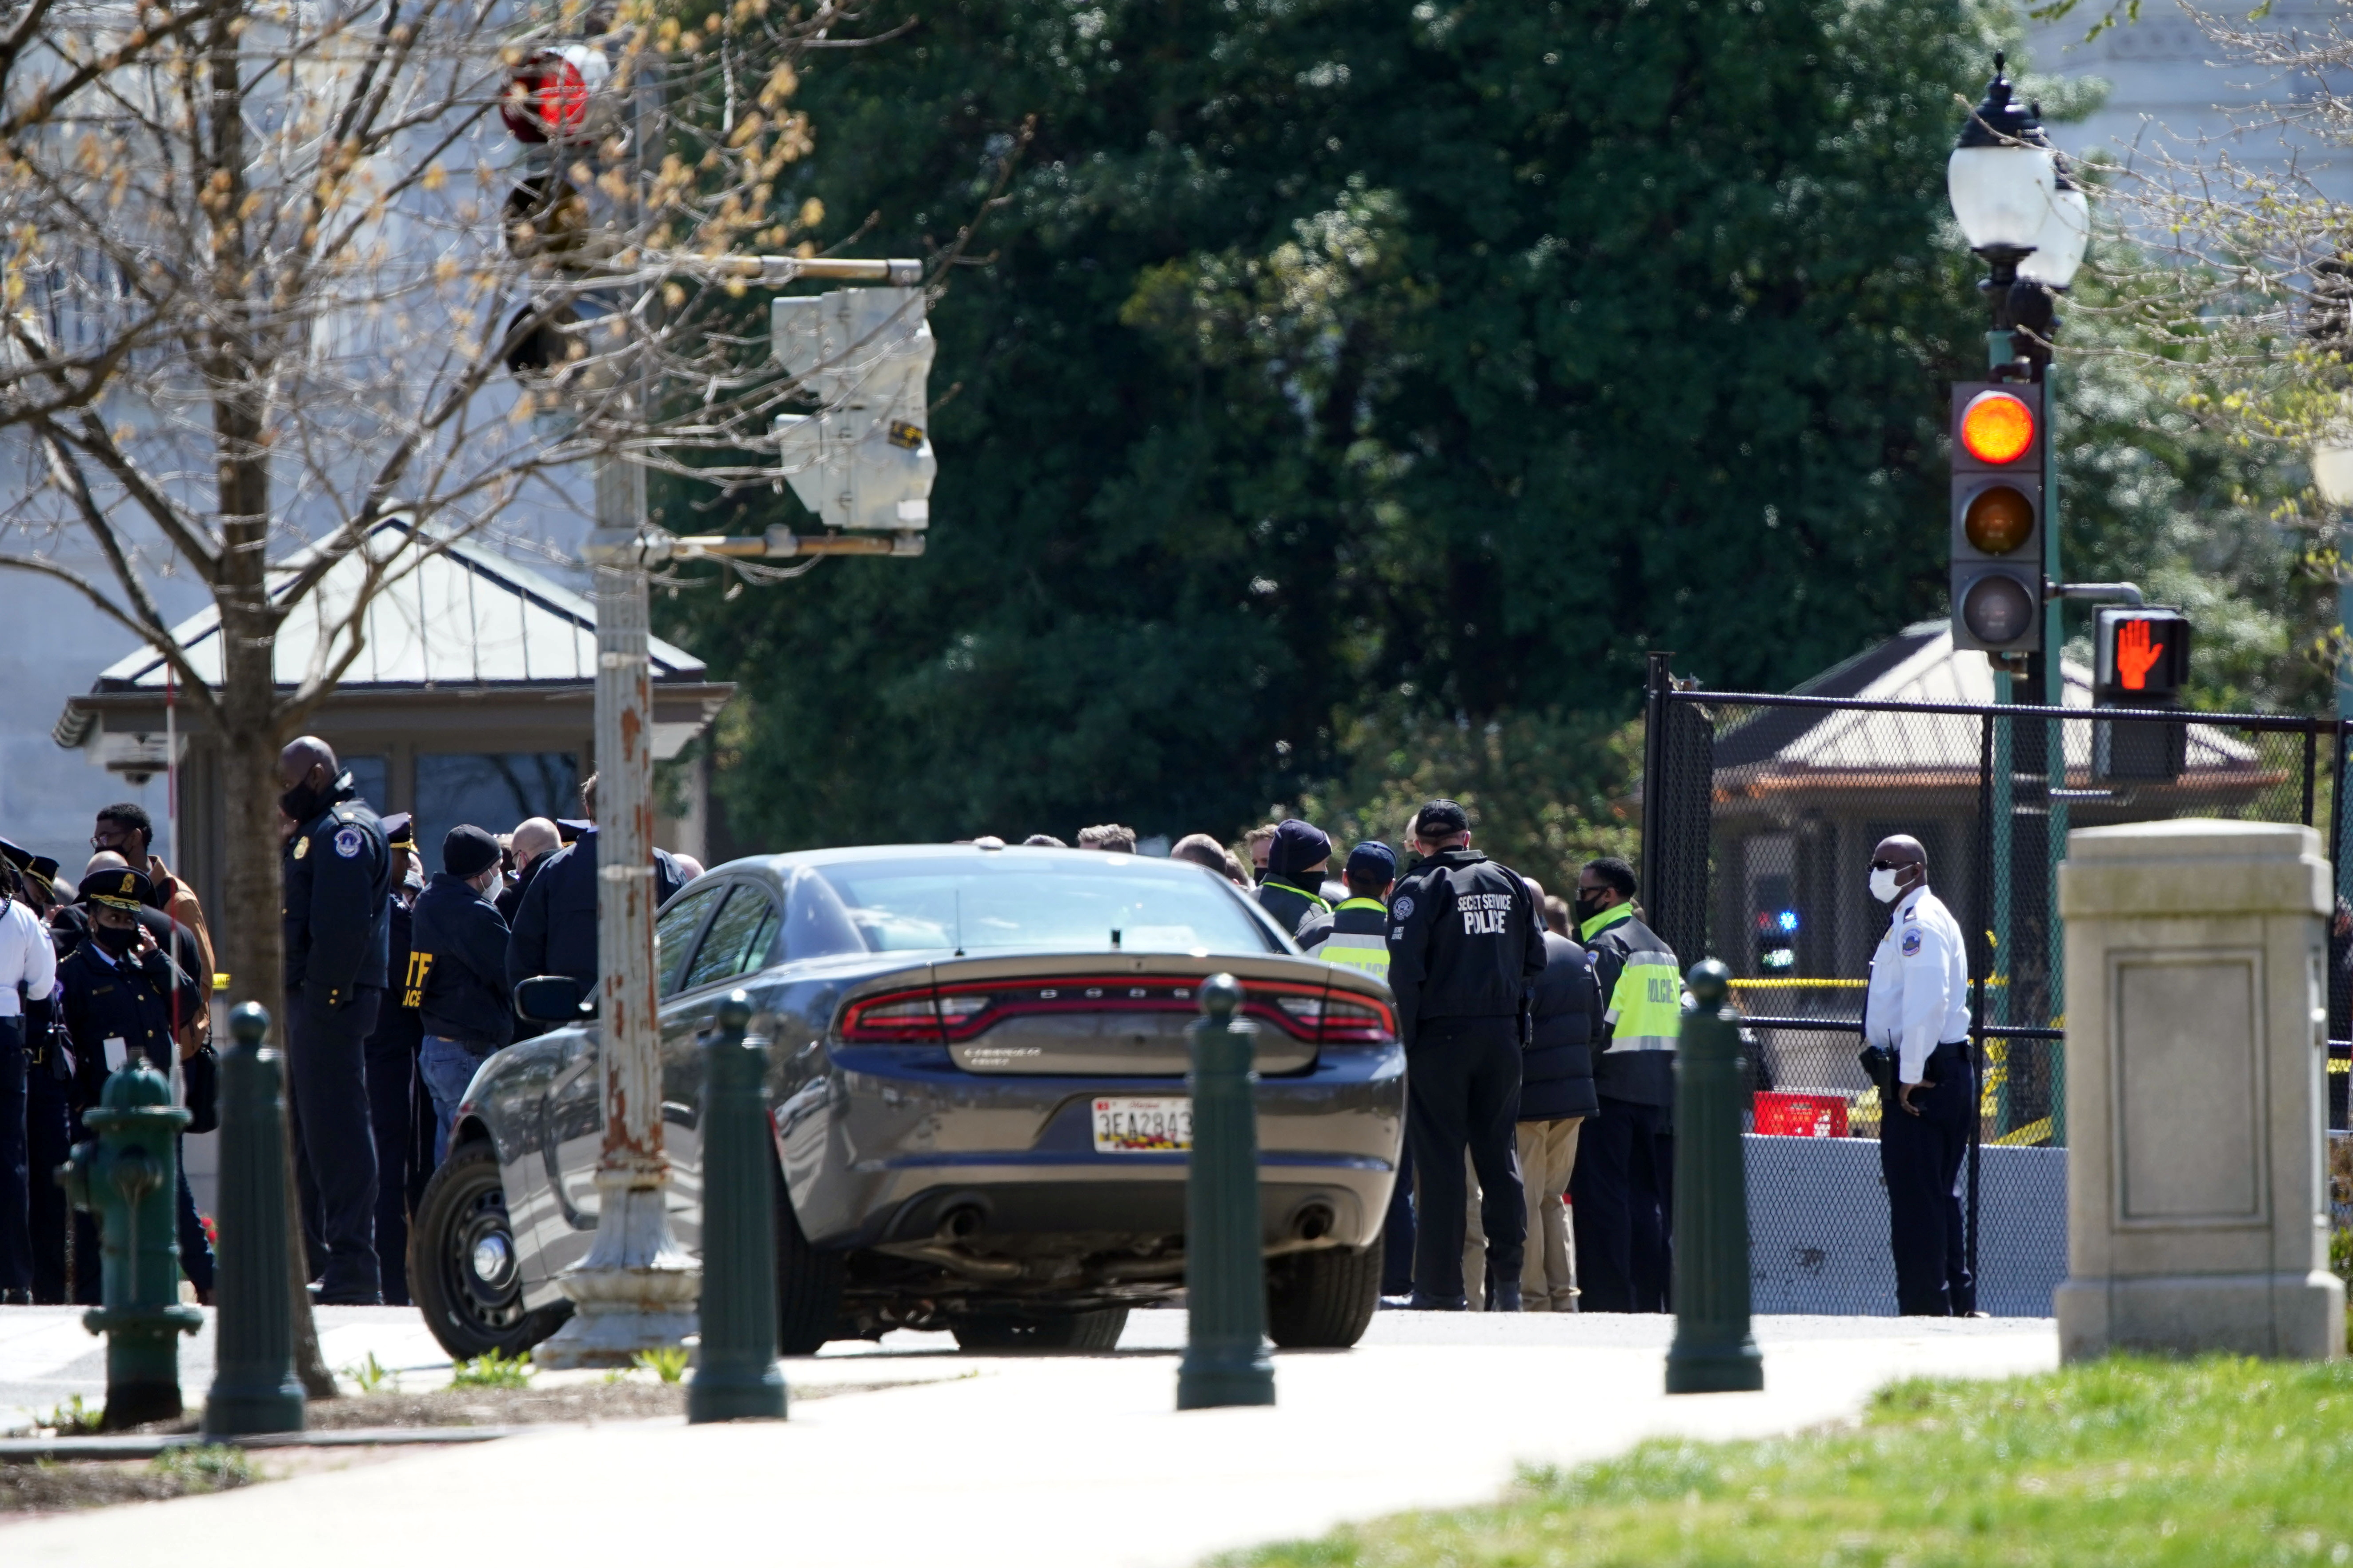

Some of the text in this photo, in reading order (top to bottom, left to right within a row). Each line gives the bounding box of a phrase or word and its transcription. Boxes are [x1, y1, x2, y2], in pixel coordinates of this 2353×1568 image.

[1426, 809, 1446, 818] POLICE
[1457, 895, 1482, 912] SECET
[1463, 909, 1506, 934] POLICE
[405, 951, 433, 988] TF
